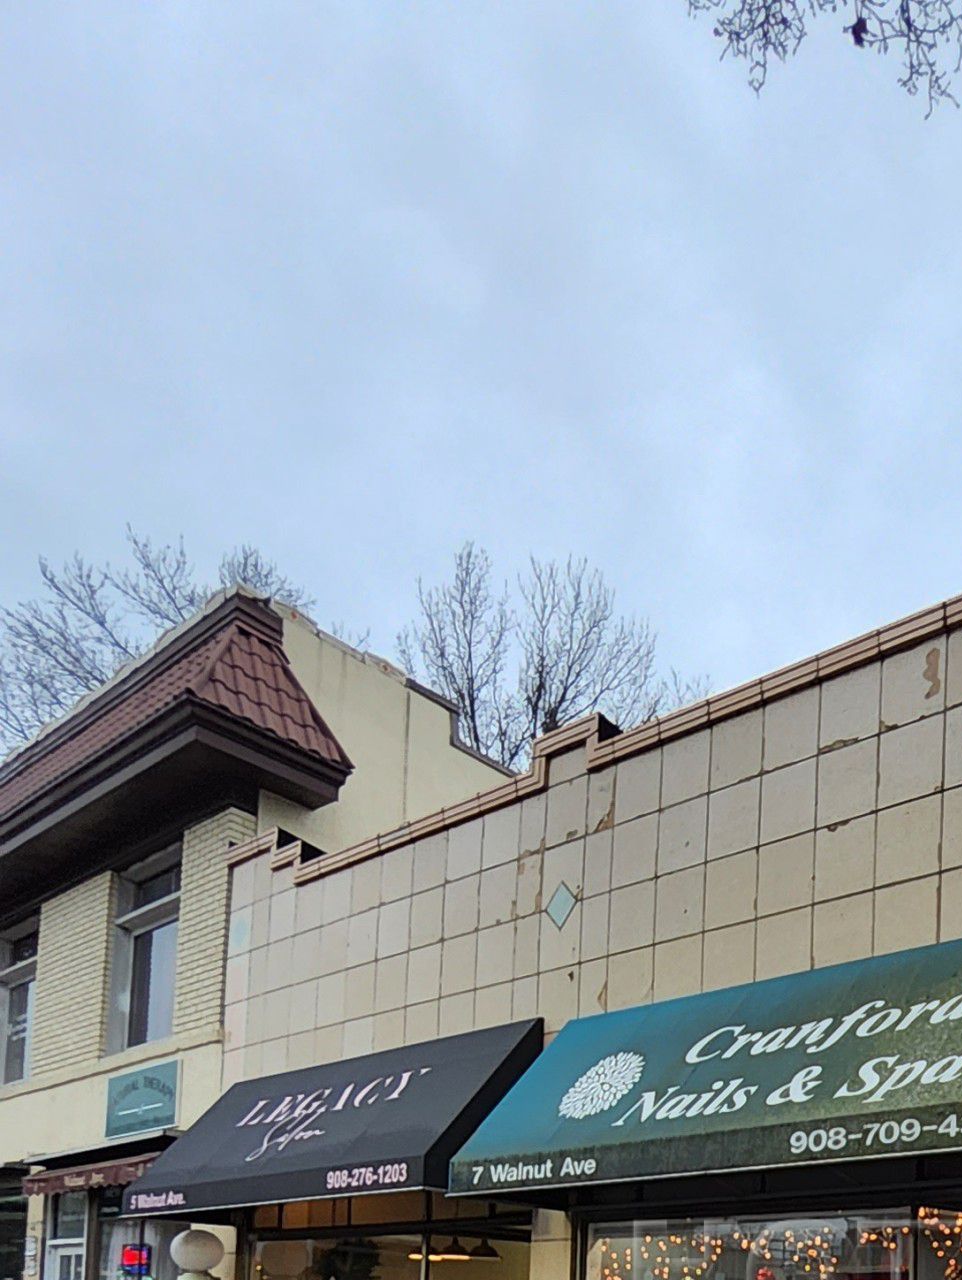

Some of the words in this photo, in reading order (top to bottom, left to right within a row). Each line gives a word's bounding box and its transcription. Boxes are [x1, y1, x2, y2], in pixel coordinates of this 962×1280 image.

[235, 1067, 432, 1127] LEGACY
[611, 1077, 759, 1127] Nails
[765, 1064, 824, 1106] &
[325, 1162, 408, 1190] 908-276-1203
[472, 1166, 483, 1185] 7
[489, 1158, 553, 1183] Walnut
[560, 1156, 597, 1177] Ave
[129, 1195, 137, 1210] 5
